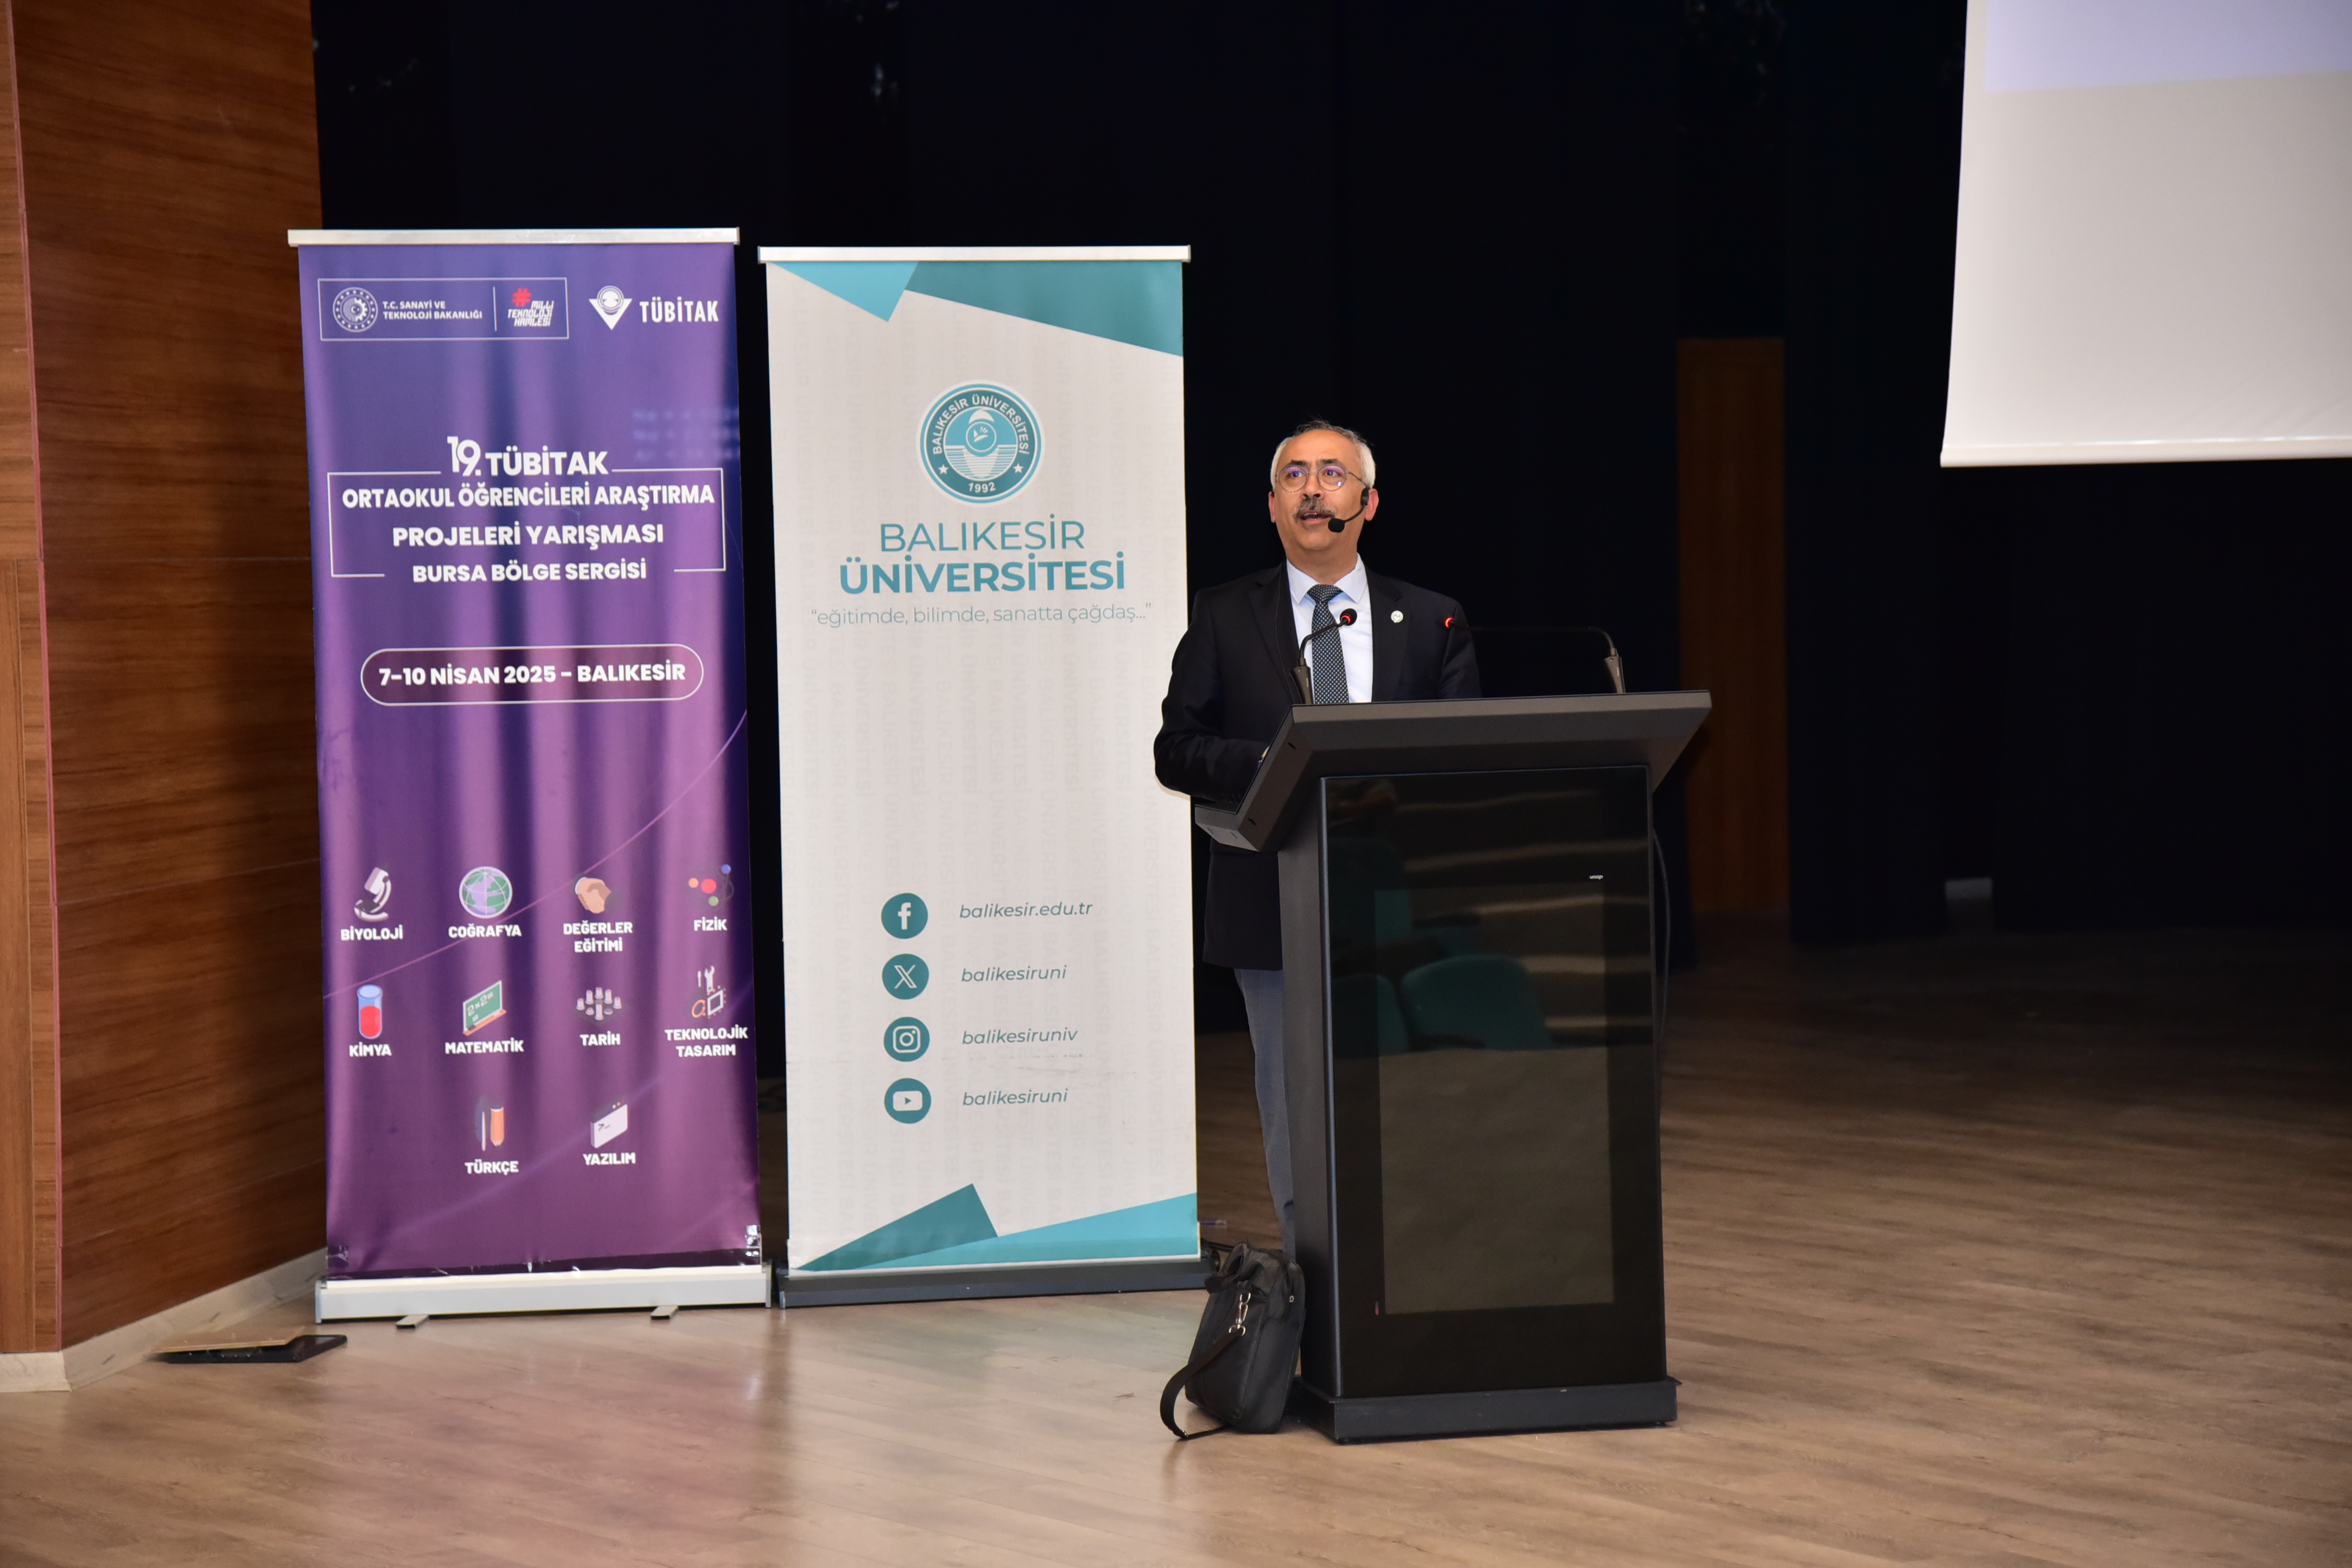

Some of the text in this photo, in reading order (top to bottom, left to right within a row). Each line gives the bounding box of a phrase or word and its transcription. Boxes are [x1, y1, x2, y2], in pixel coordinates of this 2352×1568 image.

[382, 300, 446, 310] T.C. SANAYİ VE
[639, 296, 719, 323] TÜBİTAK
[383, 310, 482, 320] TEKNOLOJİ BAKANLIĞI
[932, 398, 969, 455] BALIKESİR
[972, 394, 1030, 455] ÜNİVERSİTESİ
[447, 436, 609, 476] 19. TÜBİTAK
[342, 481, 715, 511] ORTAOKUL ÖĞRENCİLERİ ARAŞTIRMA
[968, 482, 996, 493] 1992
[393, 521, 664, 550] PROJELERİ YARIŞMASI
[880, 513, 1085, 552] BALIKESİR
[413, 557, 646, 582] BURSA BÖLGE SERGİSİ
[840, 550, 1124, 595] ÜNİVERSİTESİ
[914, 606, 989, 624] bilimde,
[994, 607, 1063, 621] sanatta
[430, 663, 499, 685] NİSAN
[504, 665, 557, 683] 2025
[577, 659, 686, 682] BALIKESİR
[959, 901, 1093, 918] balikesir.edu.tr
[340, 924, 403, 941] BİYOLOJİ
[448, 923, 522, 938] COĞRAFYA
[563, 920, 633, 935] DEĞERLER
[693, 916, 727, 932] FİZİK
[574, 937, 623, 953] EĞİTİMİ
[961, 964, 1067, 982] balikesiruni
[579, 1031, 621, 1046] TARİH
[664, 1024, 748, 1041] TEKNOLOJİK
[962, 1027, 1078, 1045] balikesiruniv
[349, 1042, 392, 1057] KİMYA
[445, 1037, 524, 1054] MATEMATİK
[676, 1044, 736, 1058] TASARIM
[962, 1088, 1068, 1106] balikesiruni
[464, 1158, 519, 1175] TÜRKÇE
[583, 1152, 636, 1166] YAZILIM
